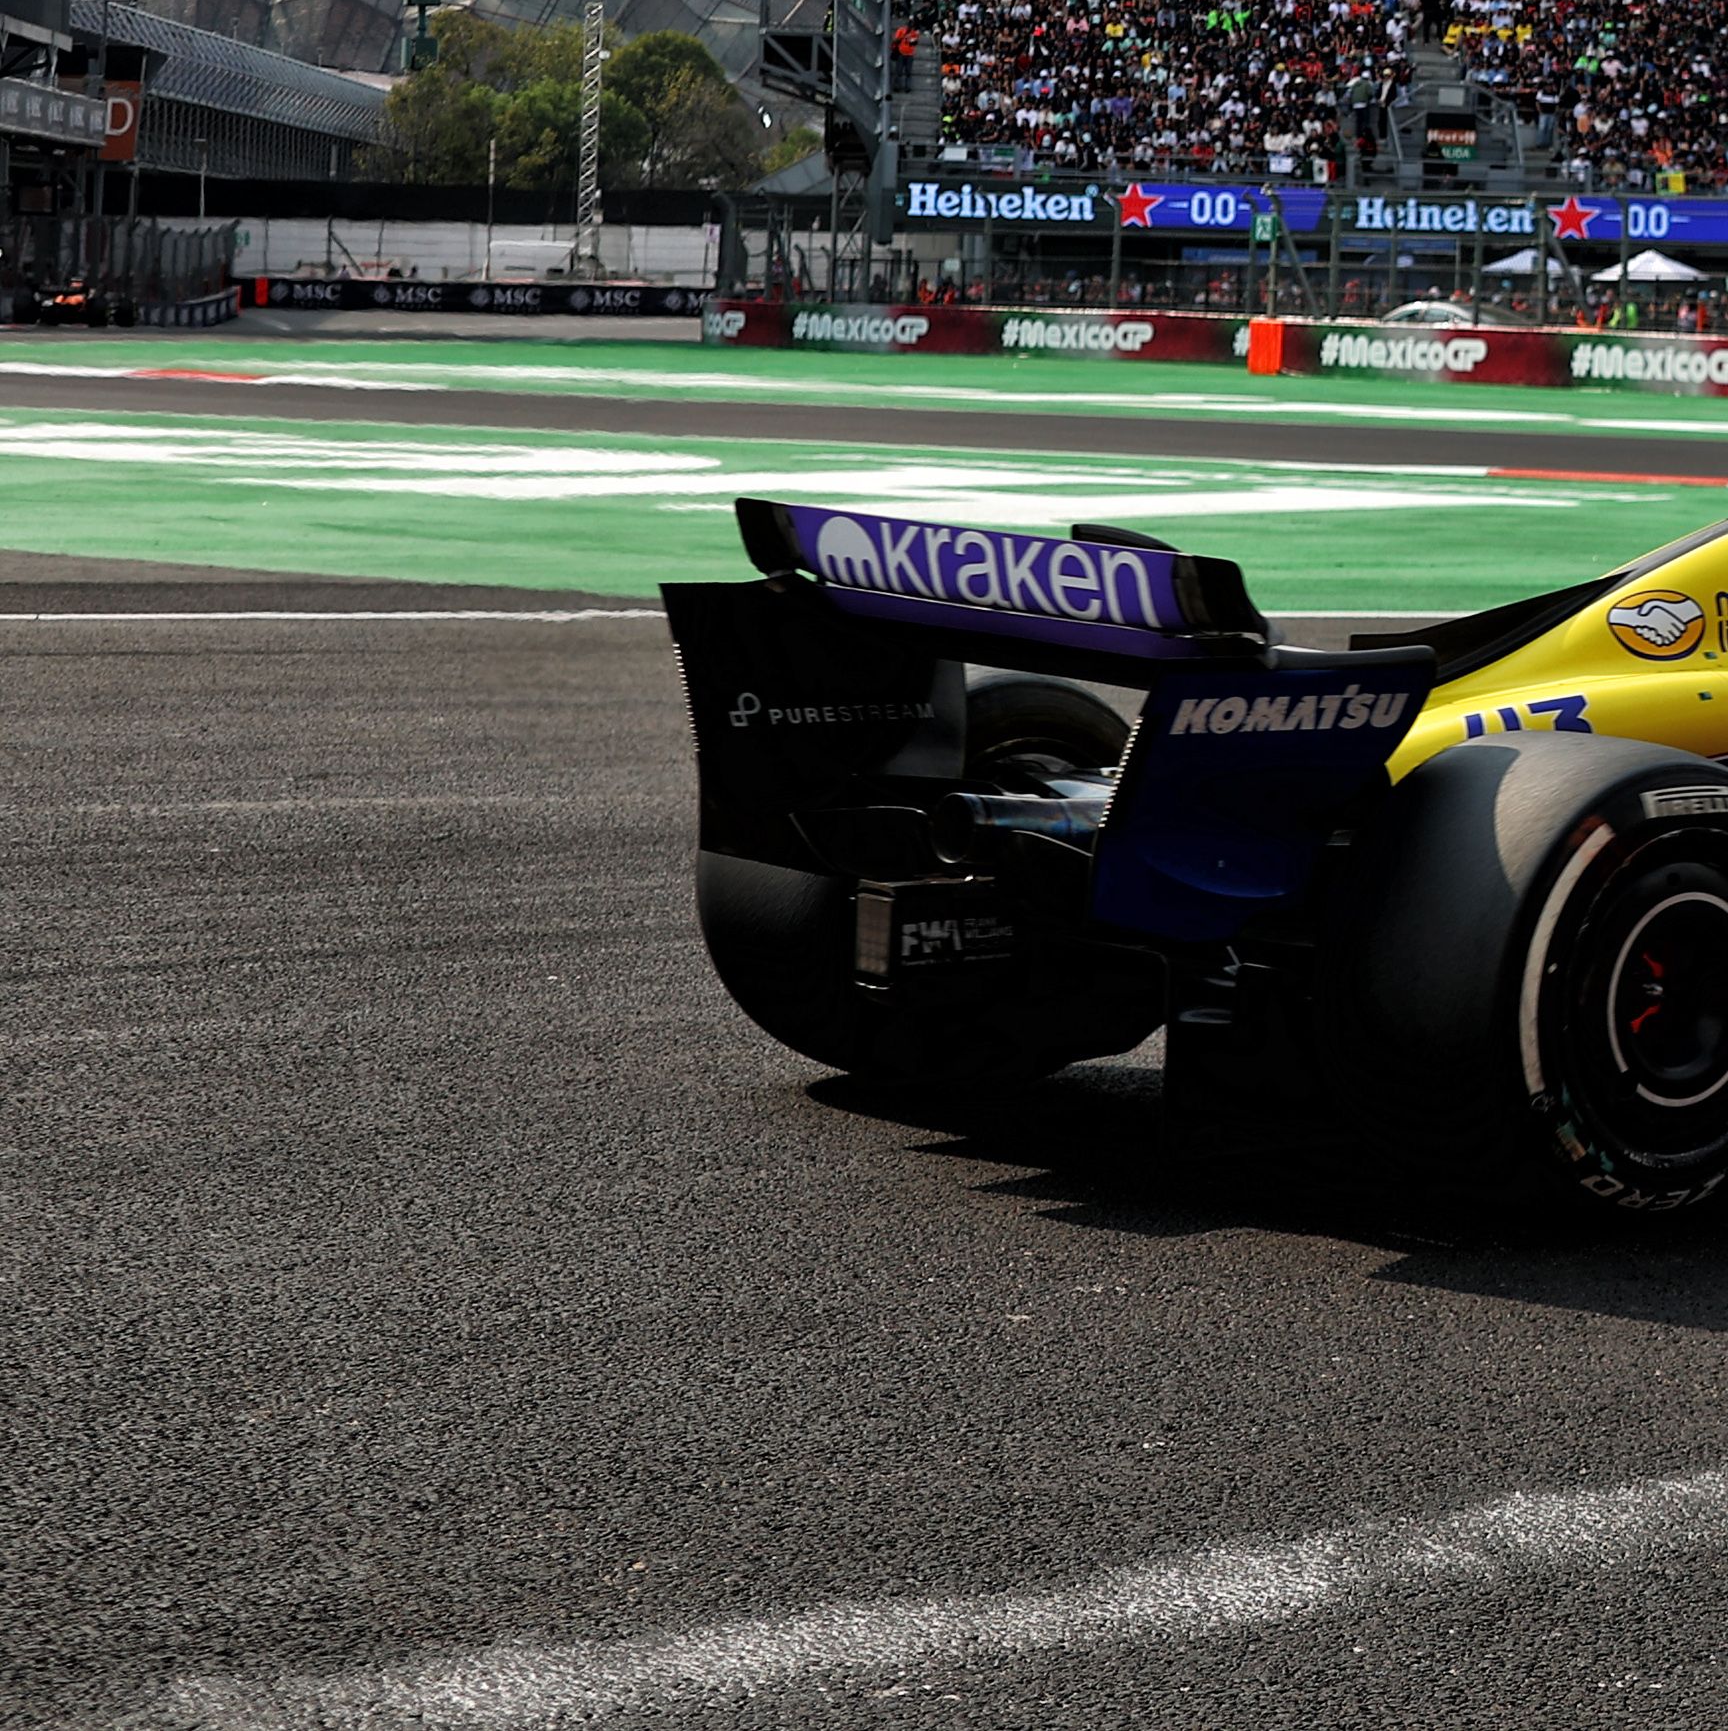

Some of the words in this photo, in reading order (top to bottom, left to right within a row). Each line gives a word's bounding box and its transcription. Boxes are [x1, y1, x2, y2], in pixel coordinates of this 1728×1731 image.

[105, 96, 134, 136] D
[1190, 190, 1237, 226] 0.0
[1627, 203, 1670, 238] 0.0
[292, 283, 341, 301] MSC
[394, 286, 443, 303] MSC
[494, 288, 541, 304] MSC
[592, 290, 640, 307] MSC
[792, 311, 930, 344] #MexicoGP
[1001, 316, 1154, 351] #MexicoGP
[1320, 334, 1488, 371] #MexicoGP
[880, 521, 1161, 629] kraken
[767, 702, 936, 726] PURESTREAM
[1169, 684, 1410, 735] KOMATSU
